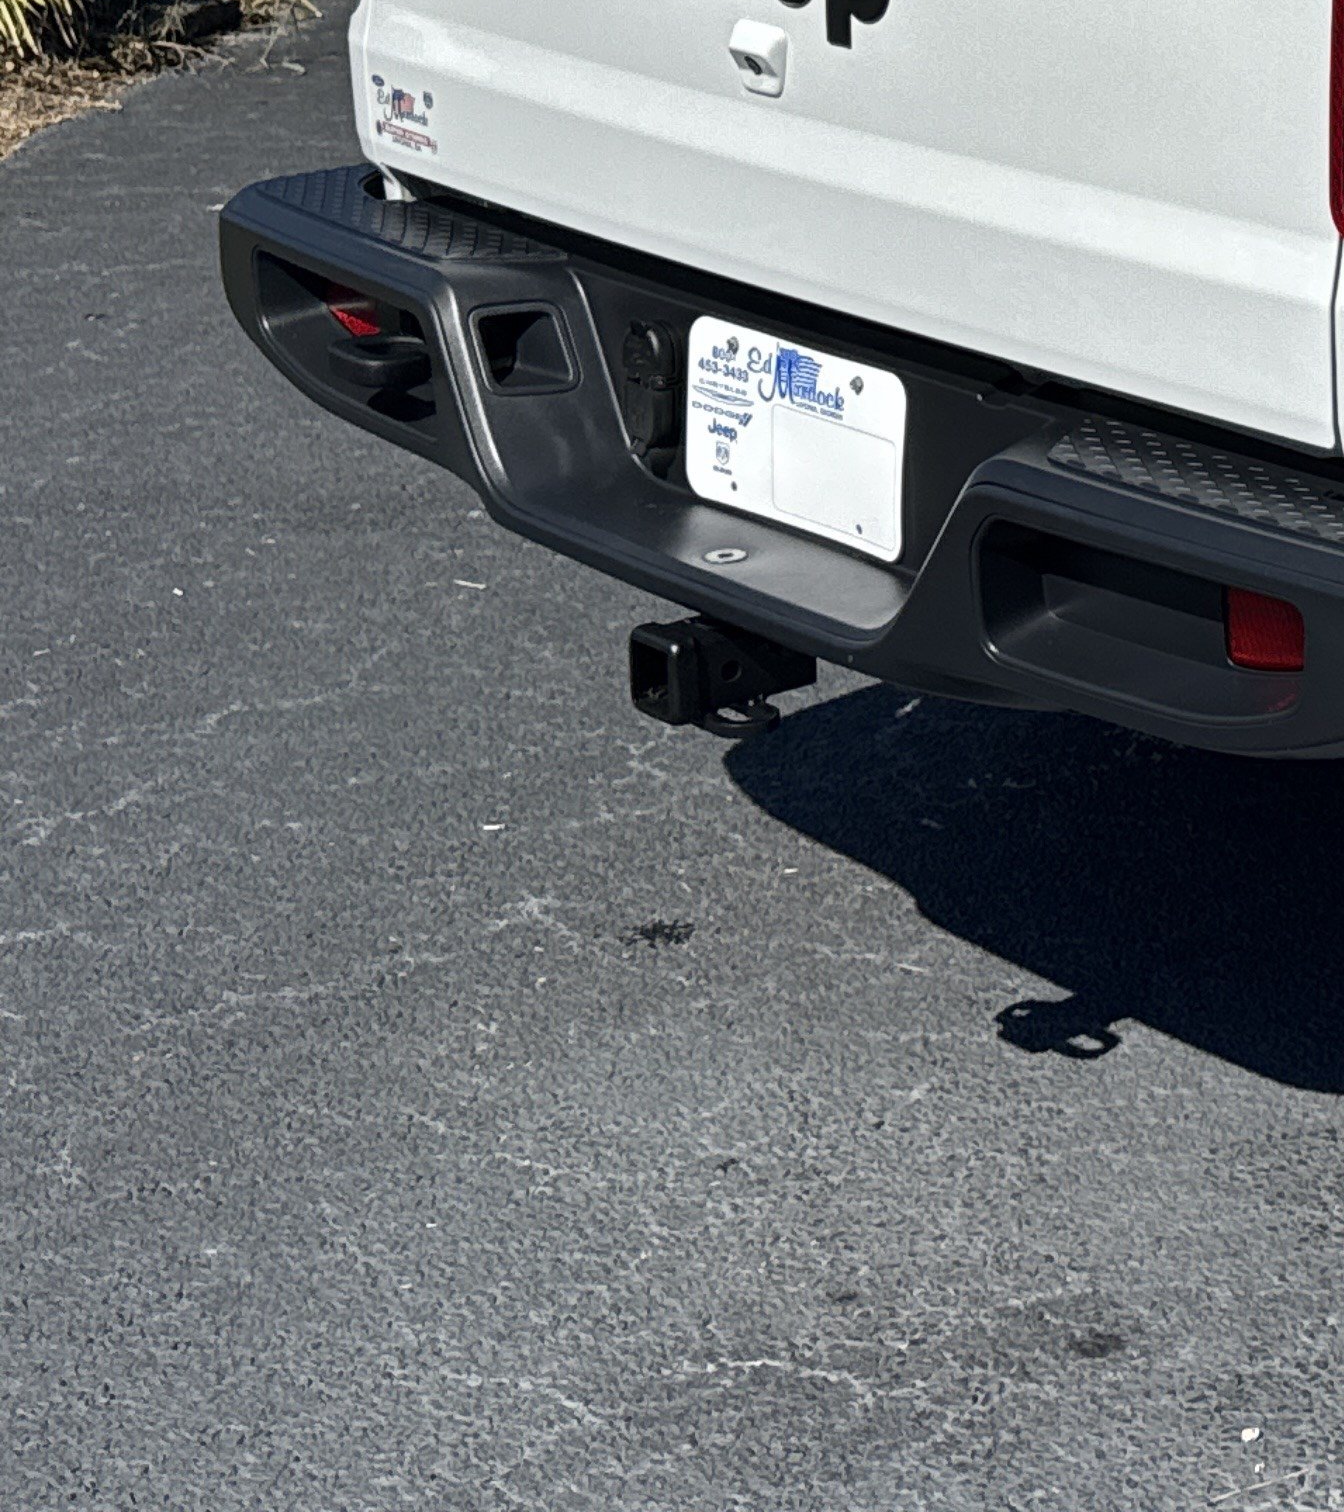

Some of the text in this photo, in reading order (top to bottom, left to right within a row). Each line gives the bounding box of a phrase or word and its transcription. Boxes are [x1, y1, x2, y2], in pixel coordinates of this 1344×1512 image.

[698, 356, 749, 384] 453-3433
[746, 346, 773, 375] Ed
[707, 417, 738, 442] Jeep
